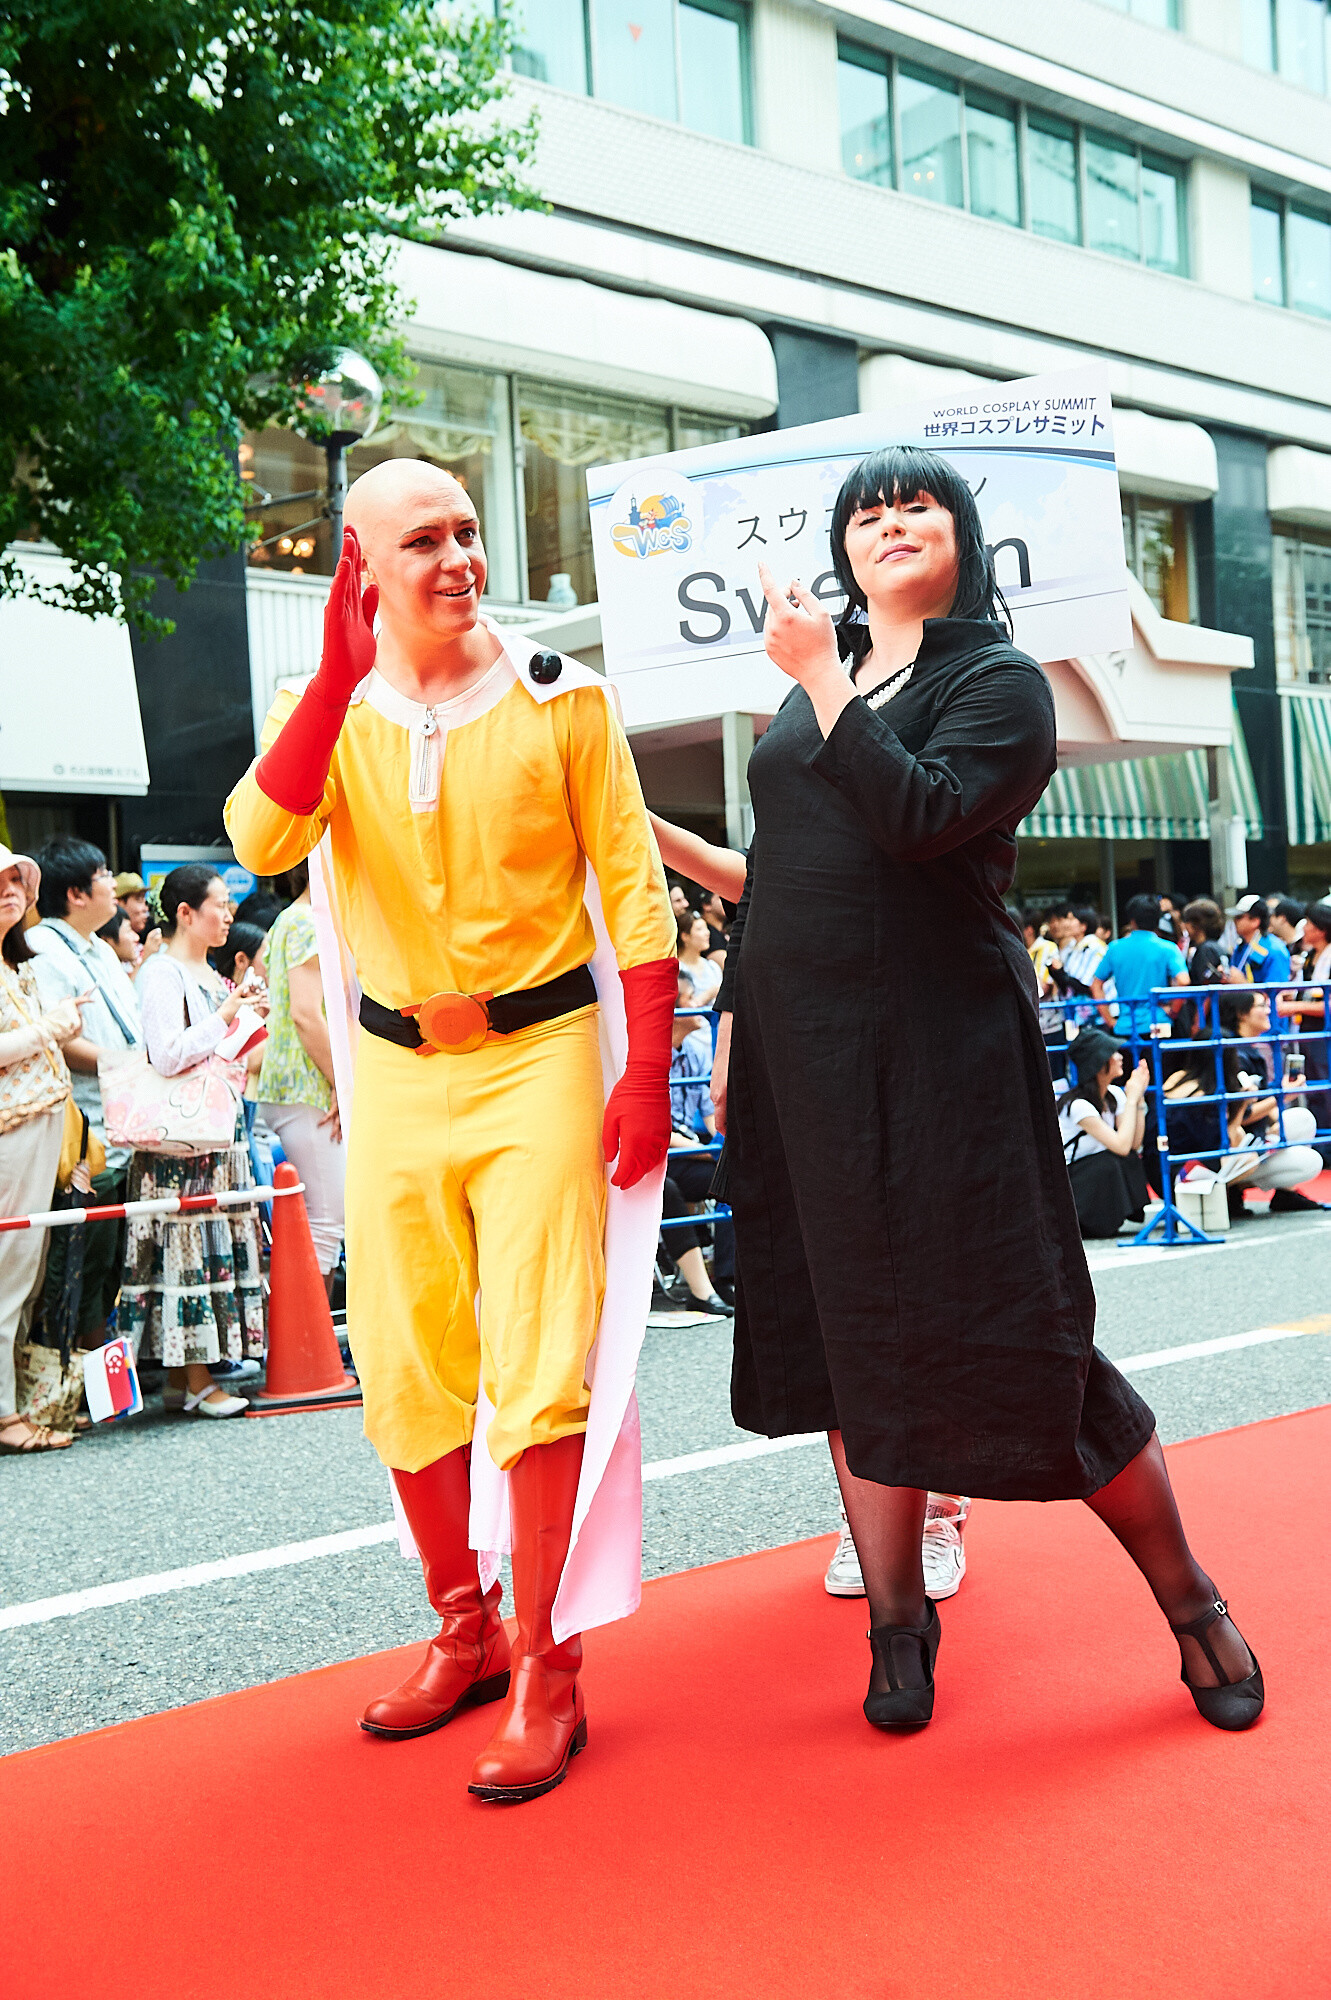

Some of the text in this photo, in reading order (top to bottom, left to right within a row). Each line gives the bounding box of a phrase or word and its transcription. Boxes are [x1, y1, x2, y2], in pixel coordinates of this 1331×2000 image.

[933, 397, 1097, 418] WORLD COSPLAY SUMMIT
[923, 414, 1106, 437] 世界コスプレサミット
[677, 537, 1032, 645] Swen
